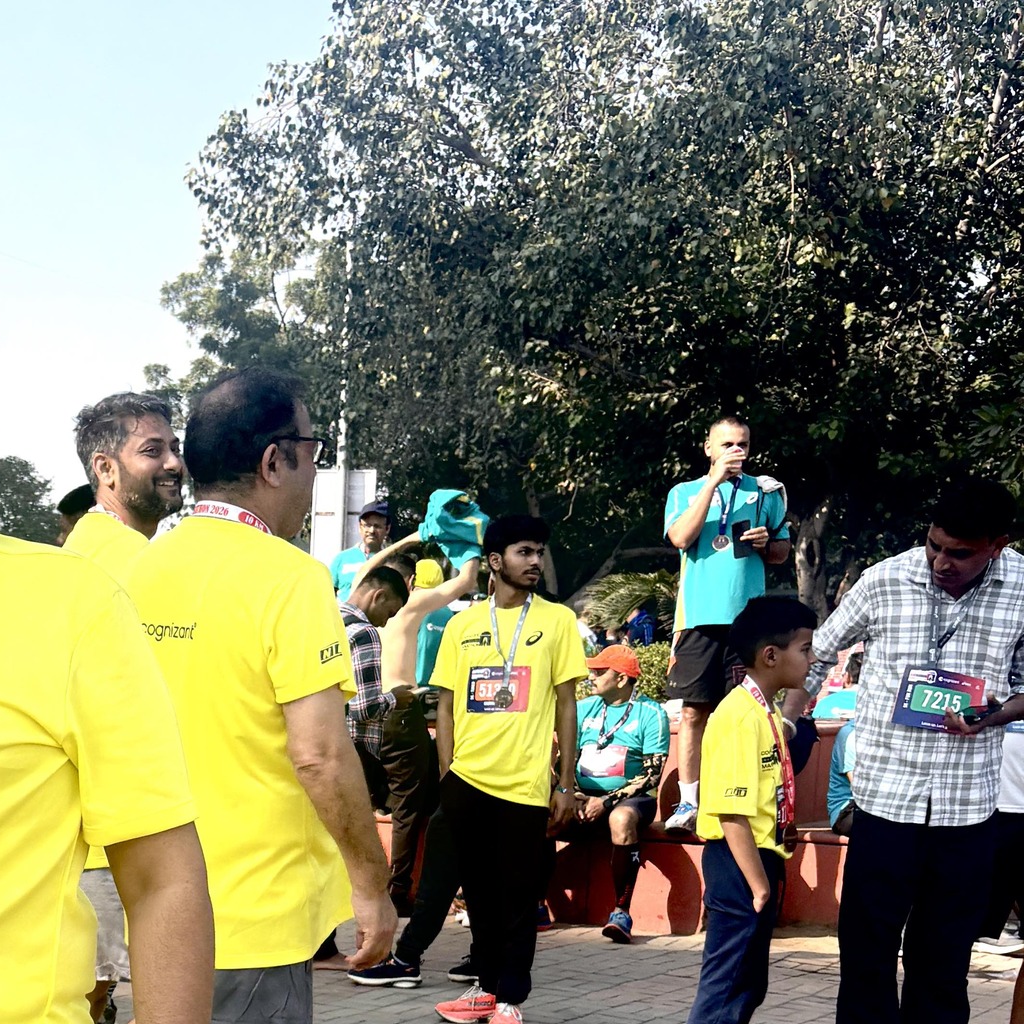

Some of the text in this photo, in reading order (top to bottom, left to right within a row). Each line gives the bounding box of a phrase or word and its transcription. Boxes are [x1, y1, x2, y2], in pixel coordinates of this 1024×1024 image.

[210, 505, 229, 517] 2026
[244, 515, 254, 524] 10
[921, 689, 963, 713] 7215
